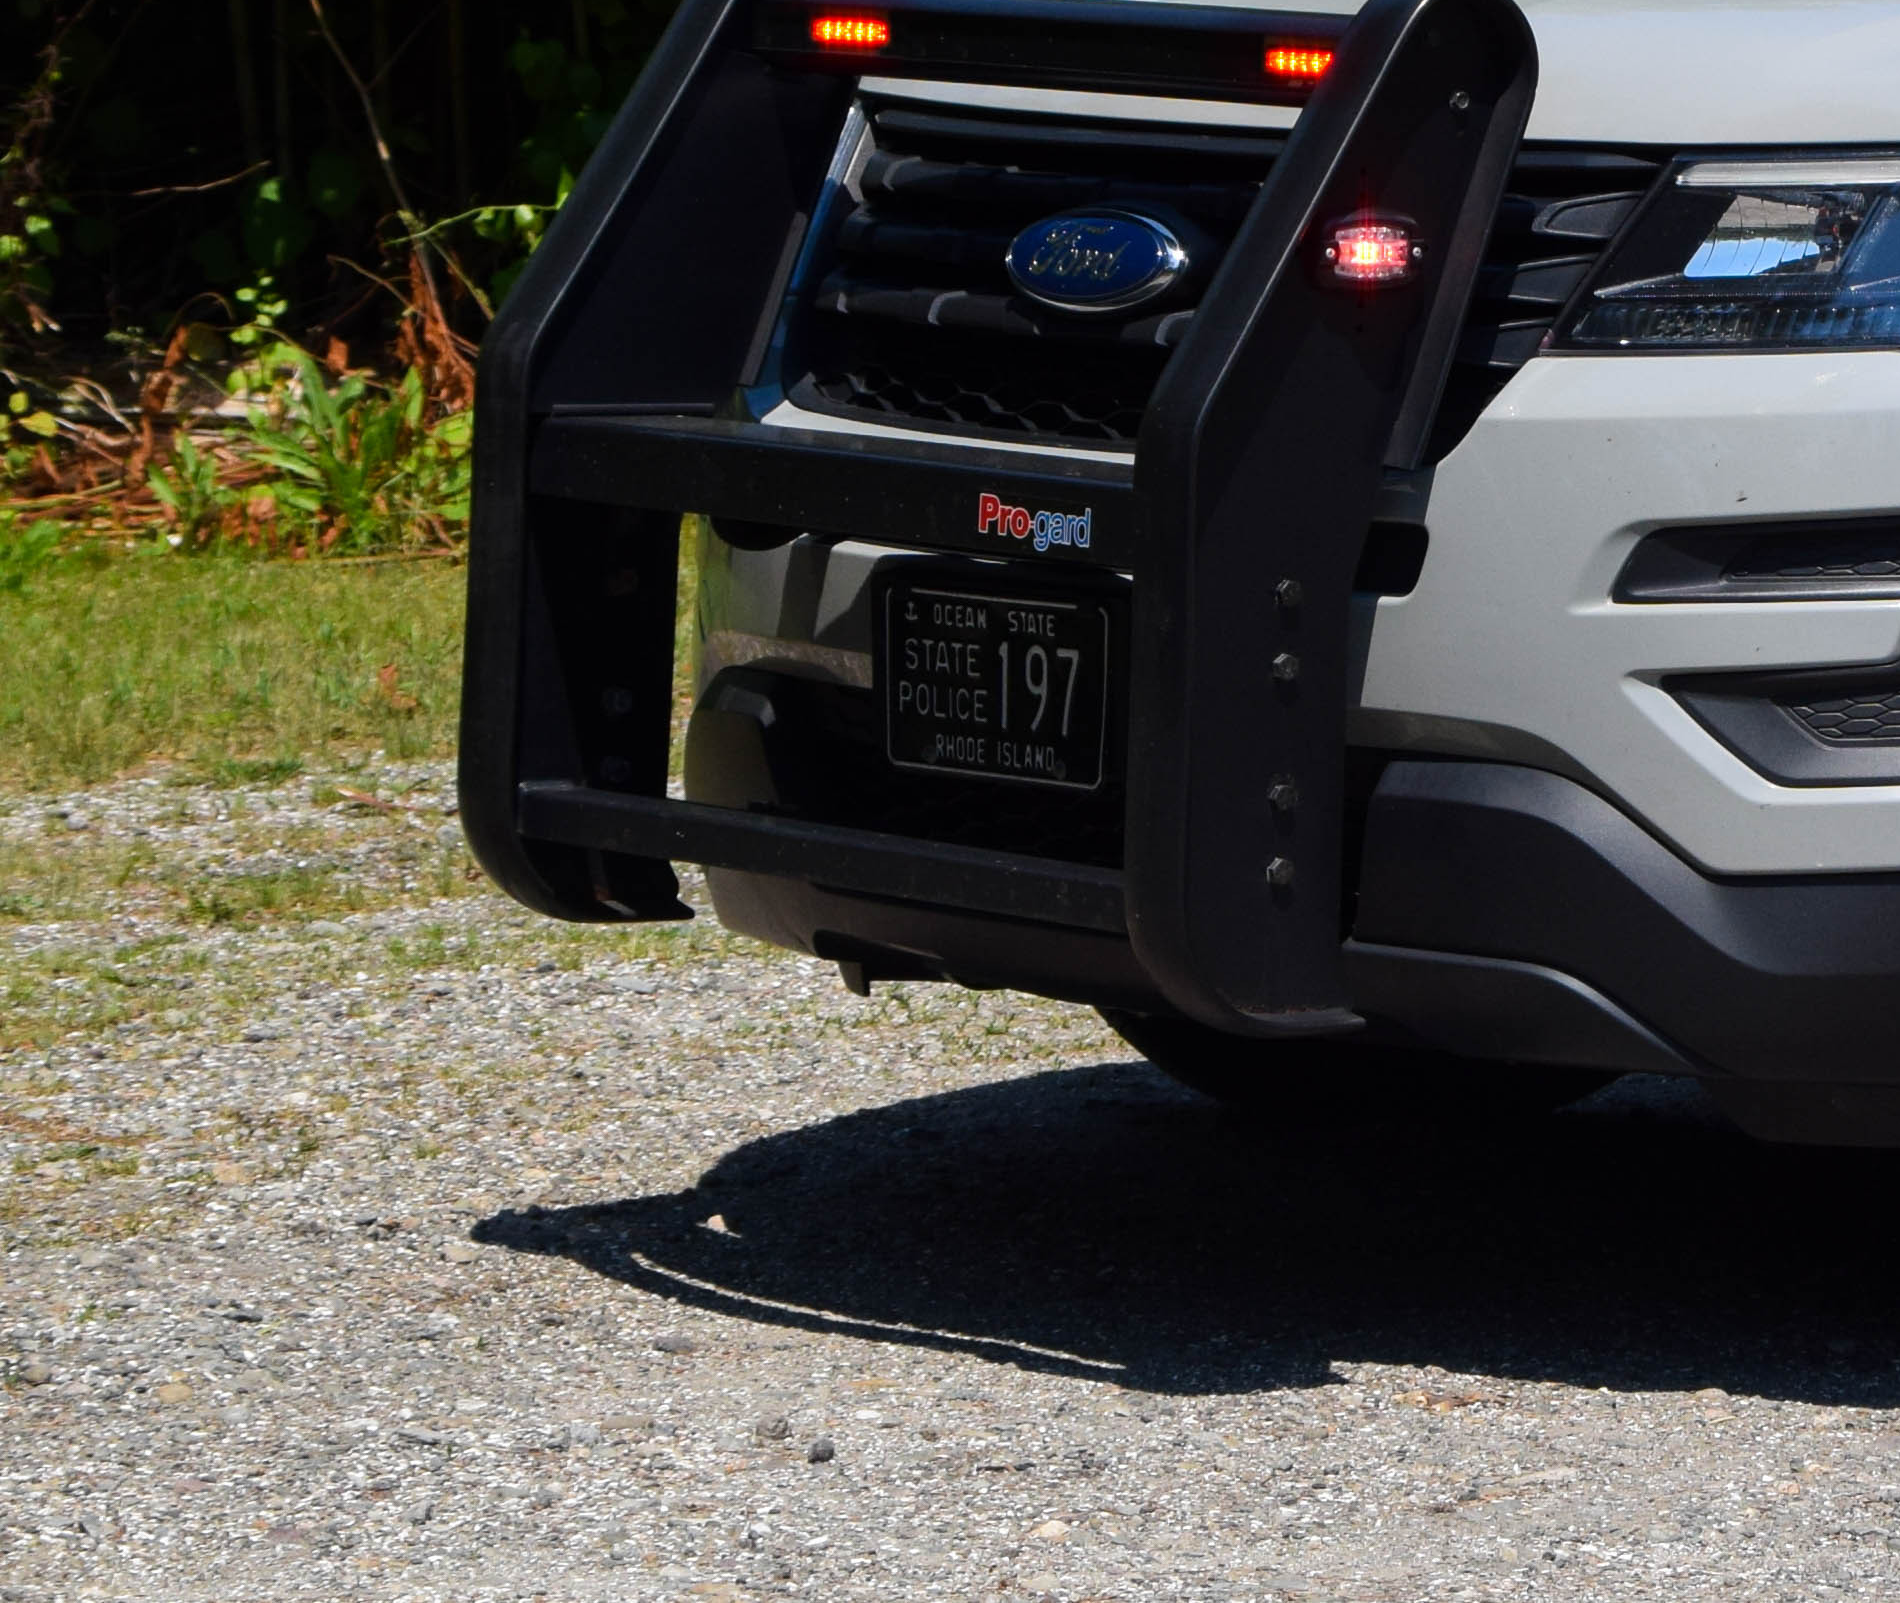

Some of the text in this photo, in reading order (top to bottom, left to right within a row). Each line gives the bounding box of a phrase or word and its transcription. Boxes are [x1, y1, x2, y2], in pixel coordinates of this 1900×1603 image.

[1028, 222, 1132, 280] Ford
[978, 493, 1091, 551] Pro-gard
[933, 603, 1055, 637] OCEAN STATE
[904, 637, 981, 678] STATE
[900, 680, 988, 724] POLICE
[998, 641, 1080, 737] 197
[935, 733, 1055, 773] RHODE ISLAND
